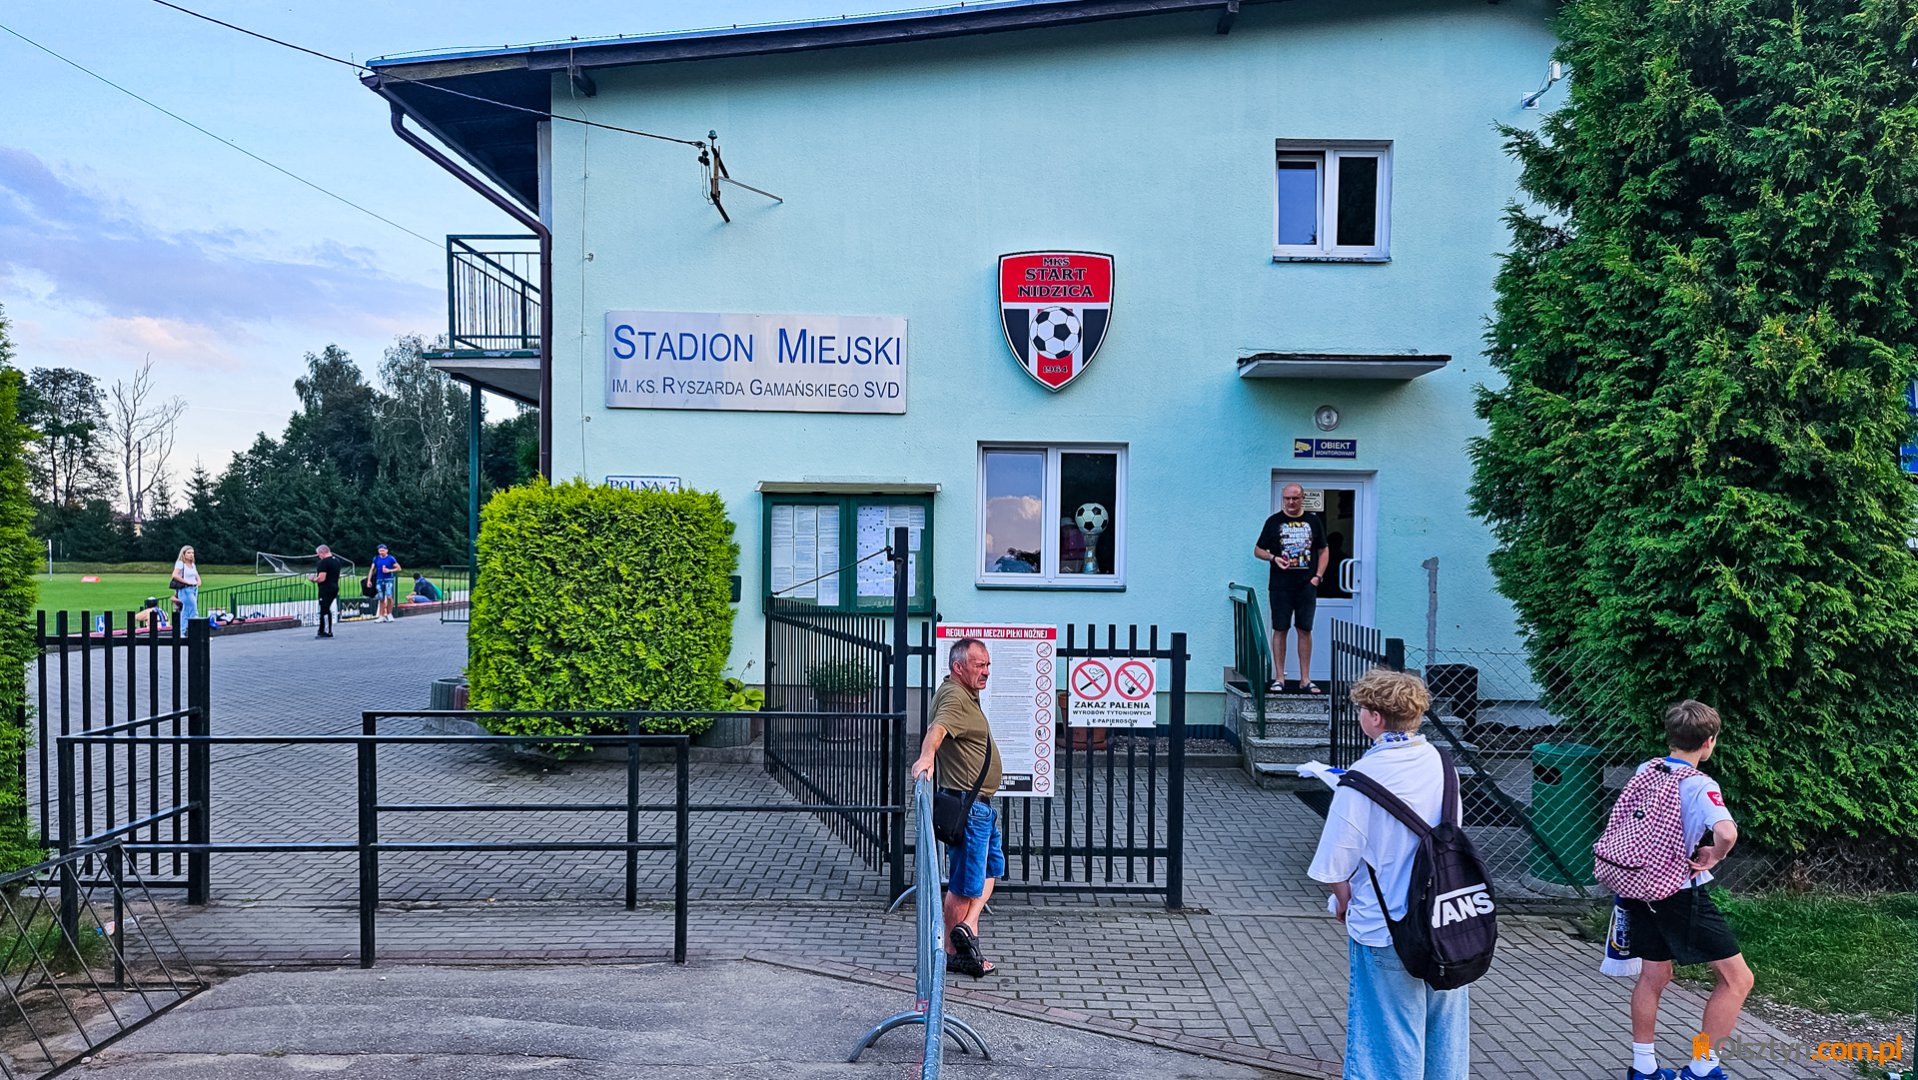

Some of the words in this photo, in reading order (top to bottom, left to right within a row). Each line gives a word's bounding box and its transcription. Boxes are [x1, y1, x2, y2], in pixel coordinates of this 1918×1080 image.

[1042, 257, 1070, 266] MKS
[1025, 268, 1087, 281] START
[1018, 284, 1094, 297] NIDZICA
[612, 324, 753, 362] STADION
[778, 328, 901, 365] MIEJSKI
[612, 379, 632, 393] IM.
[636, 379, 659, 394] KS.
[662, 377, 745, 395] RYSZARDA
[749, 378, 860, 398] GAMAŃSKIEGO
[864, 381, 900, 399] SVD
[1320, 441, 1351, 449] OBIEKT
[669, 481, 677, 492] 7
[945, 628, 982, 638] REGULAMIN
[984, 628, 1005, 638] MECZU
[1006, 629, 1022, 638] PIŁKI
[1024, 628, 1048, 639] NOŻNEJ
[1431, 882, 1495, 929] VANS
